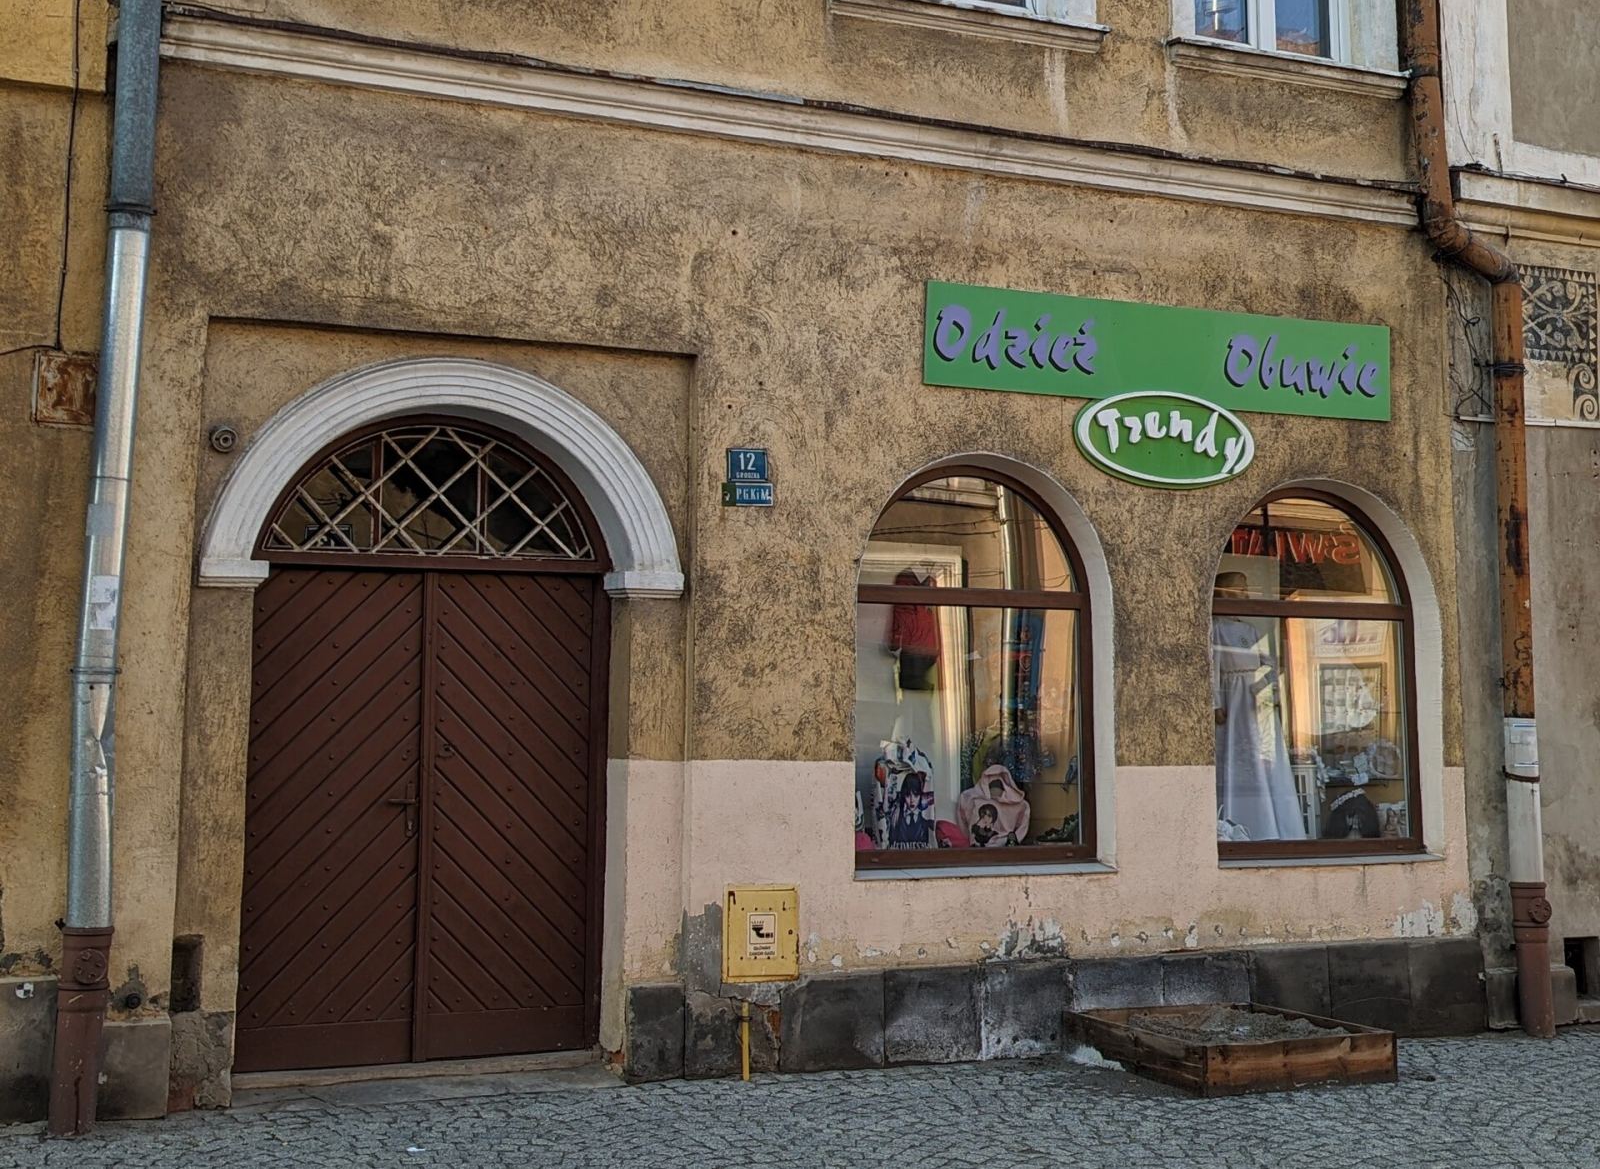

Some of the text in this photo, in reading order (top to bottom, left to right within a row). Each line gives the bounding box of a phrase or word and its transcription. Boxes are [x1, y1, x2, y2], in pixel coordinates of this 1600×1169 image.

[933, 303, 1382, 399] Odzież Obuwie
[739, 452, 757, 471] 12
[1096, 408, 1246, 474] Trendy
